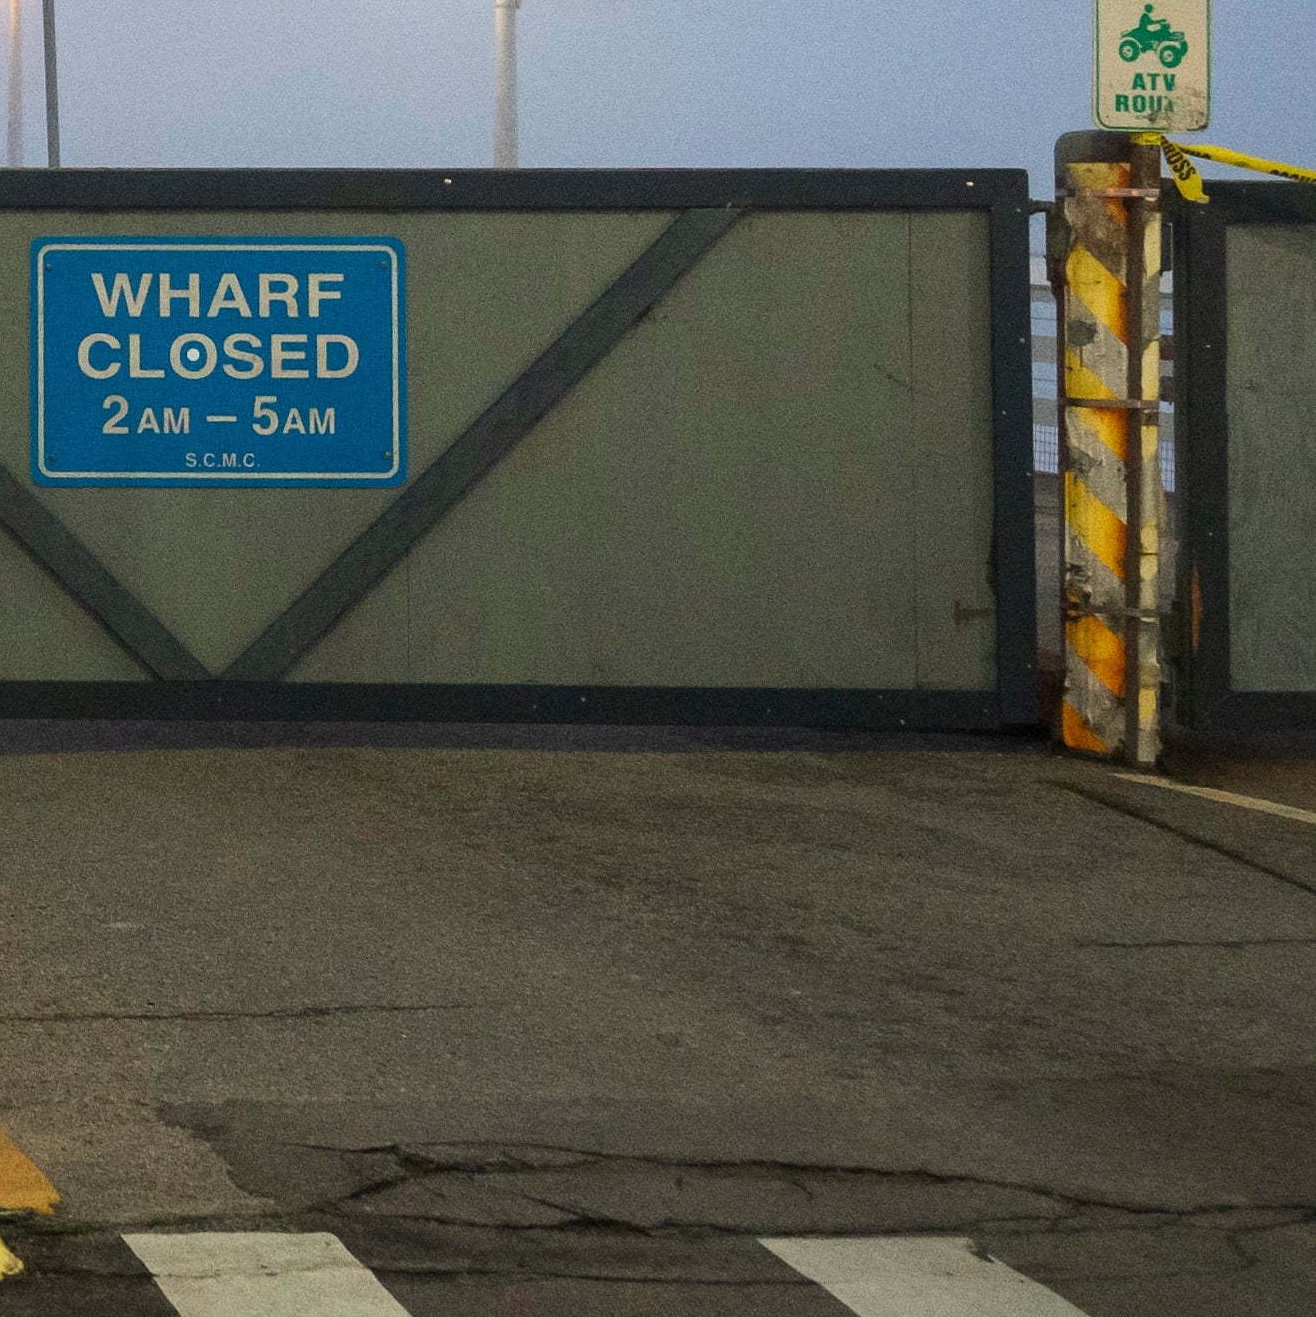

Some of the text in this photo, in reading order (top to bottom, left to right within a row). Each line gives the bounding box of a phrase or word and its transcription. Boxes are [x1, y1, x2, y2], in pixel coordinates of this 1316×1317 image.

[1132, 72, 1176, 91] ATV
[91, 272, 345, 318] WHARF
[77, 332, 360, 380] CLOSED
[252, 395, 336, 435] 5AM
